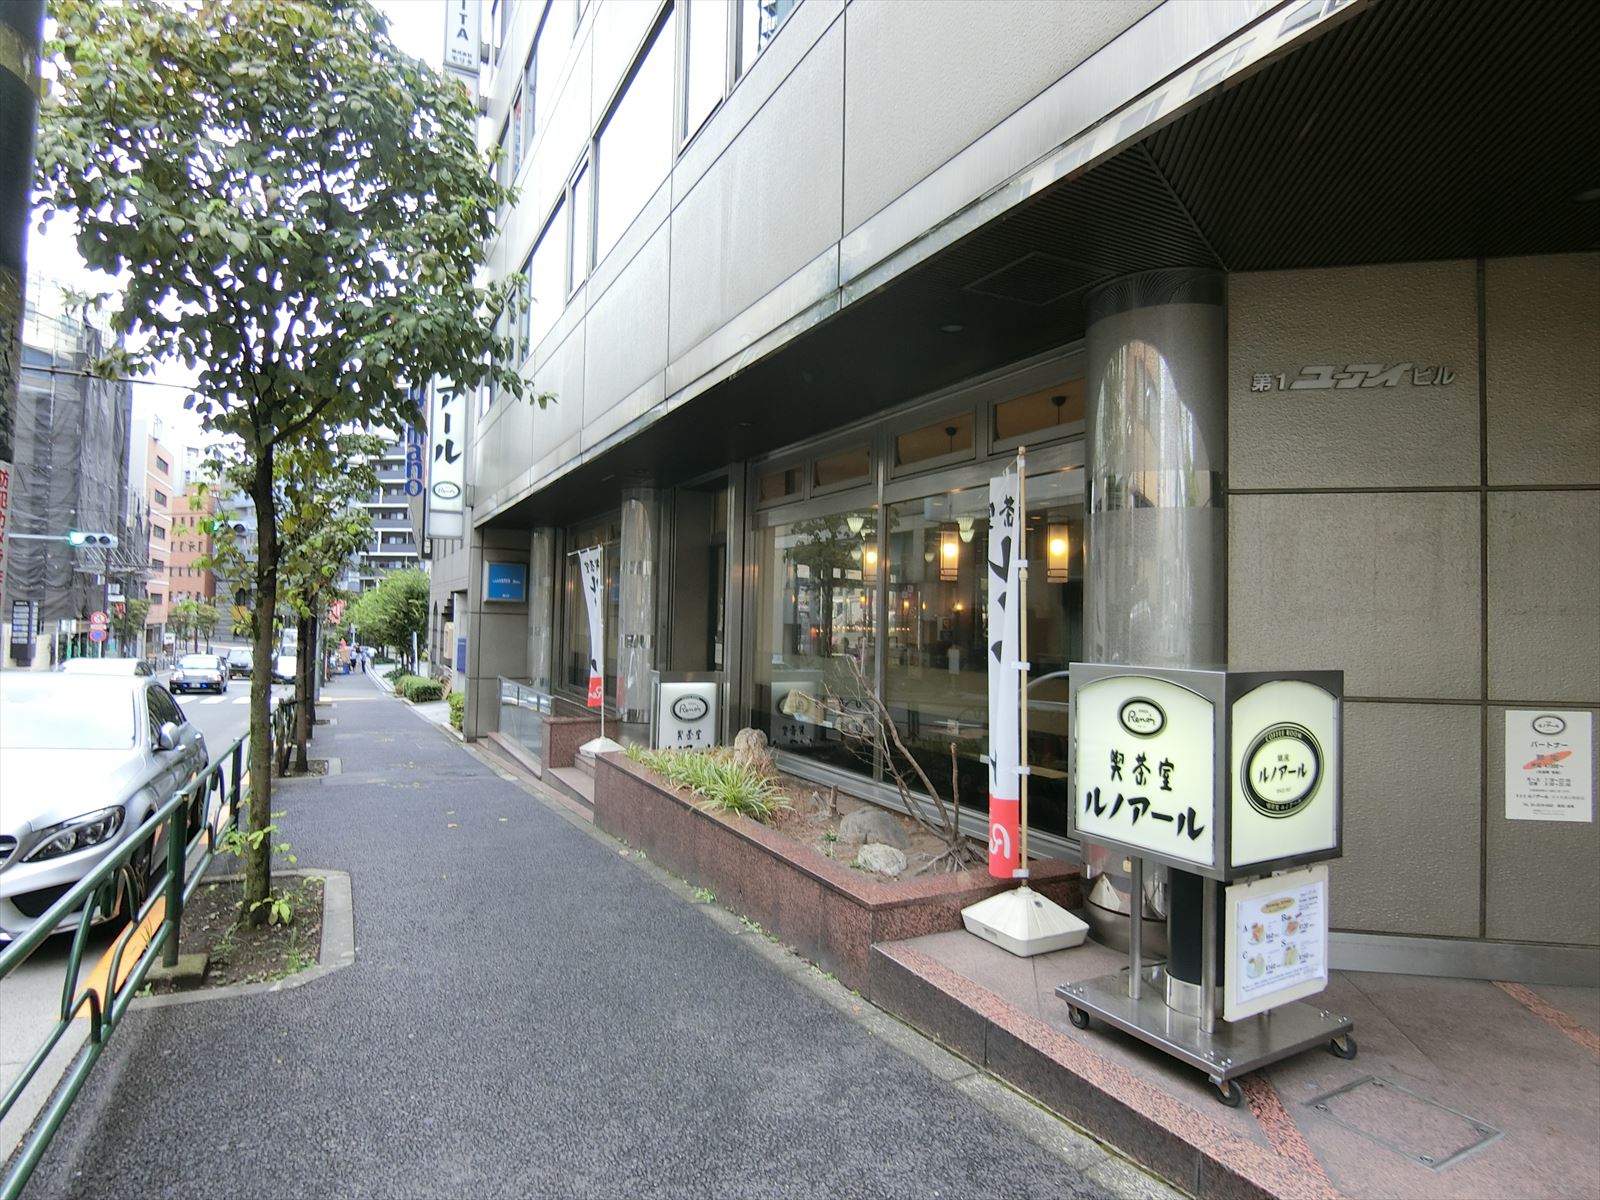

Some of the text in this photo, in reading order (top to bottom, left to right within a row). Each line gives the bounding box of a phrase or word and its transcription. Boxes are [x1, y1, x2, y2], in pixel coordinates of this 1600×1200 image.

[1110, 749, 1175, 791] 喫茶室
[1258, 763, 1307, 783] ルノアール
[1085, 786, 1205, 841] ルノアール
